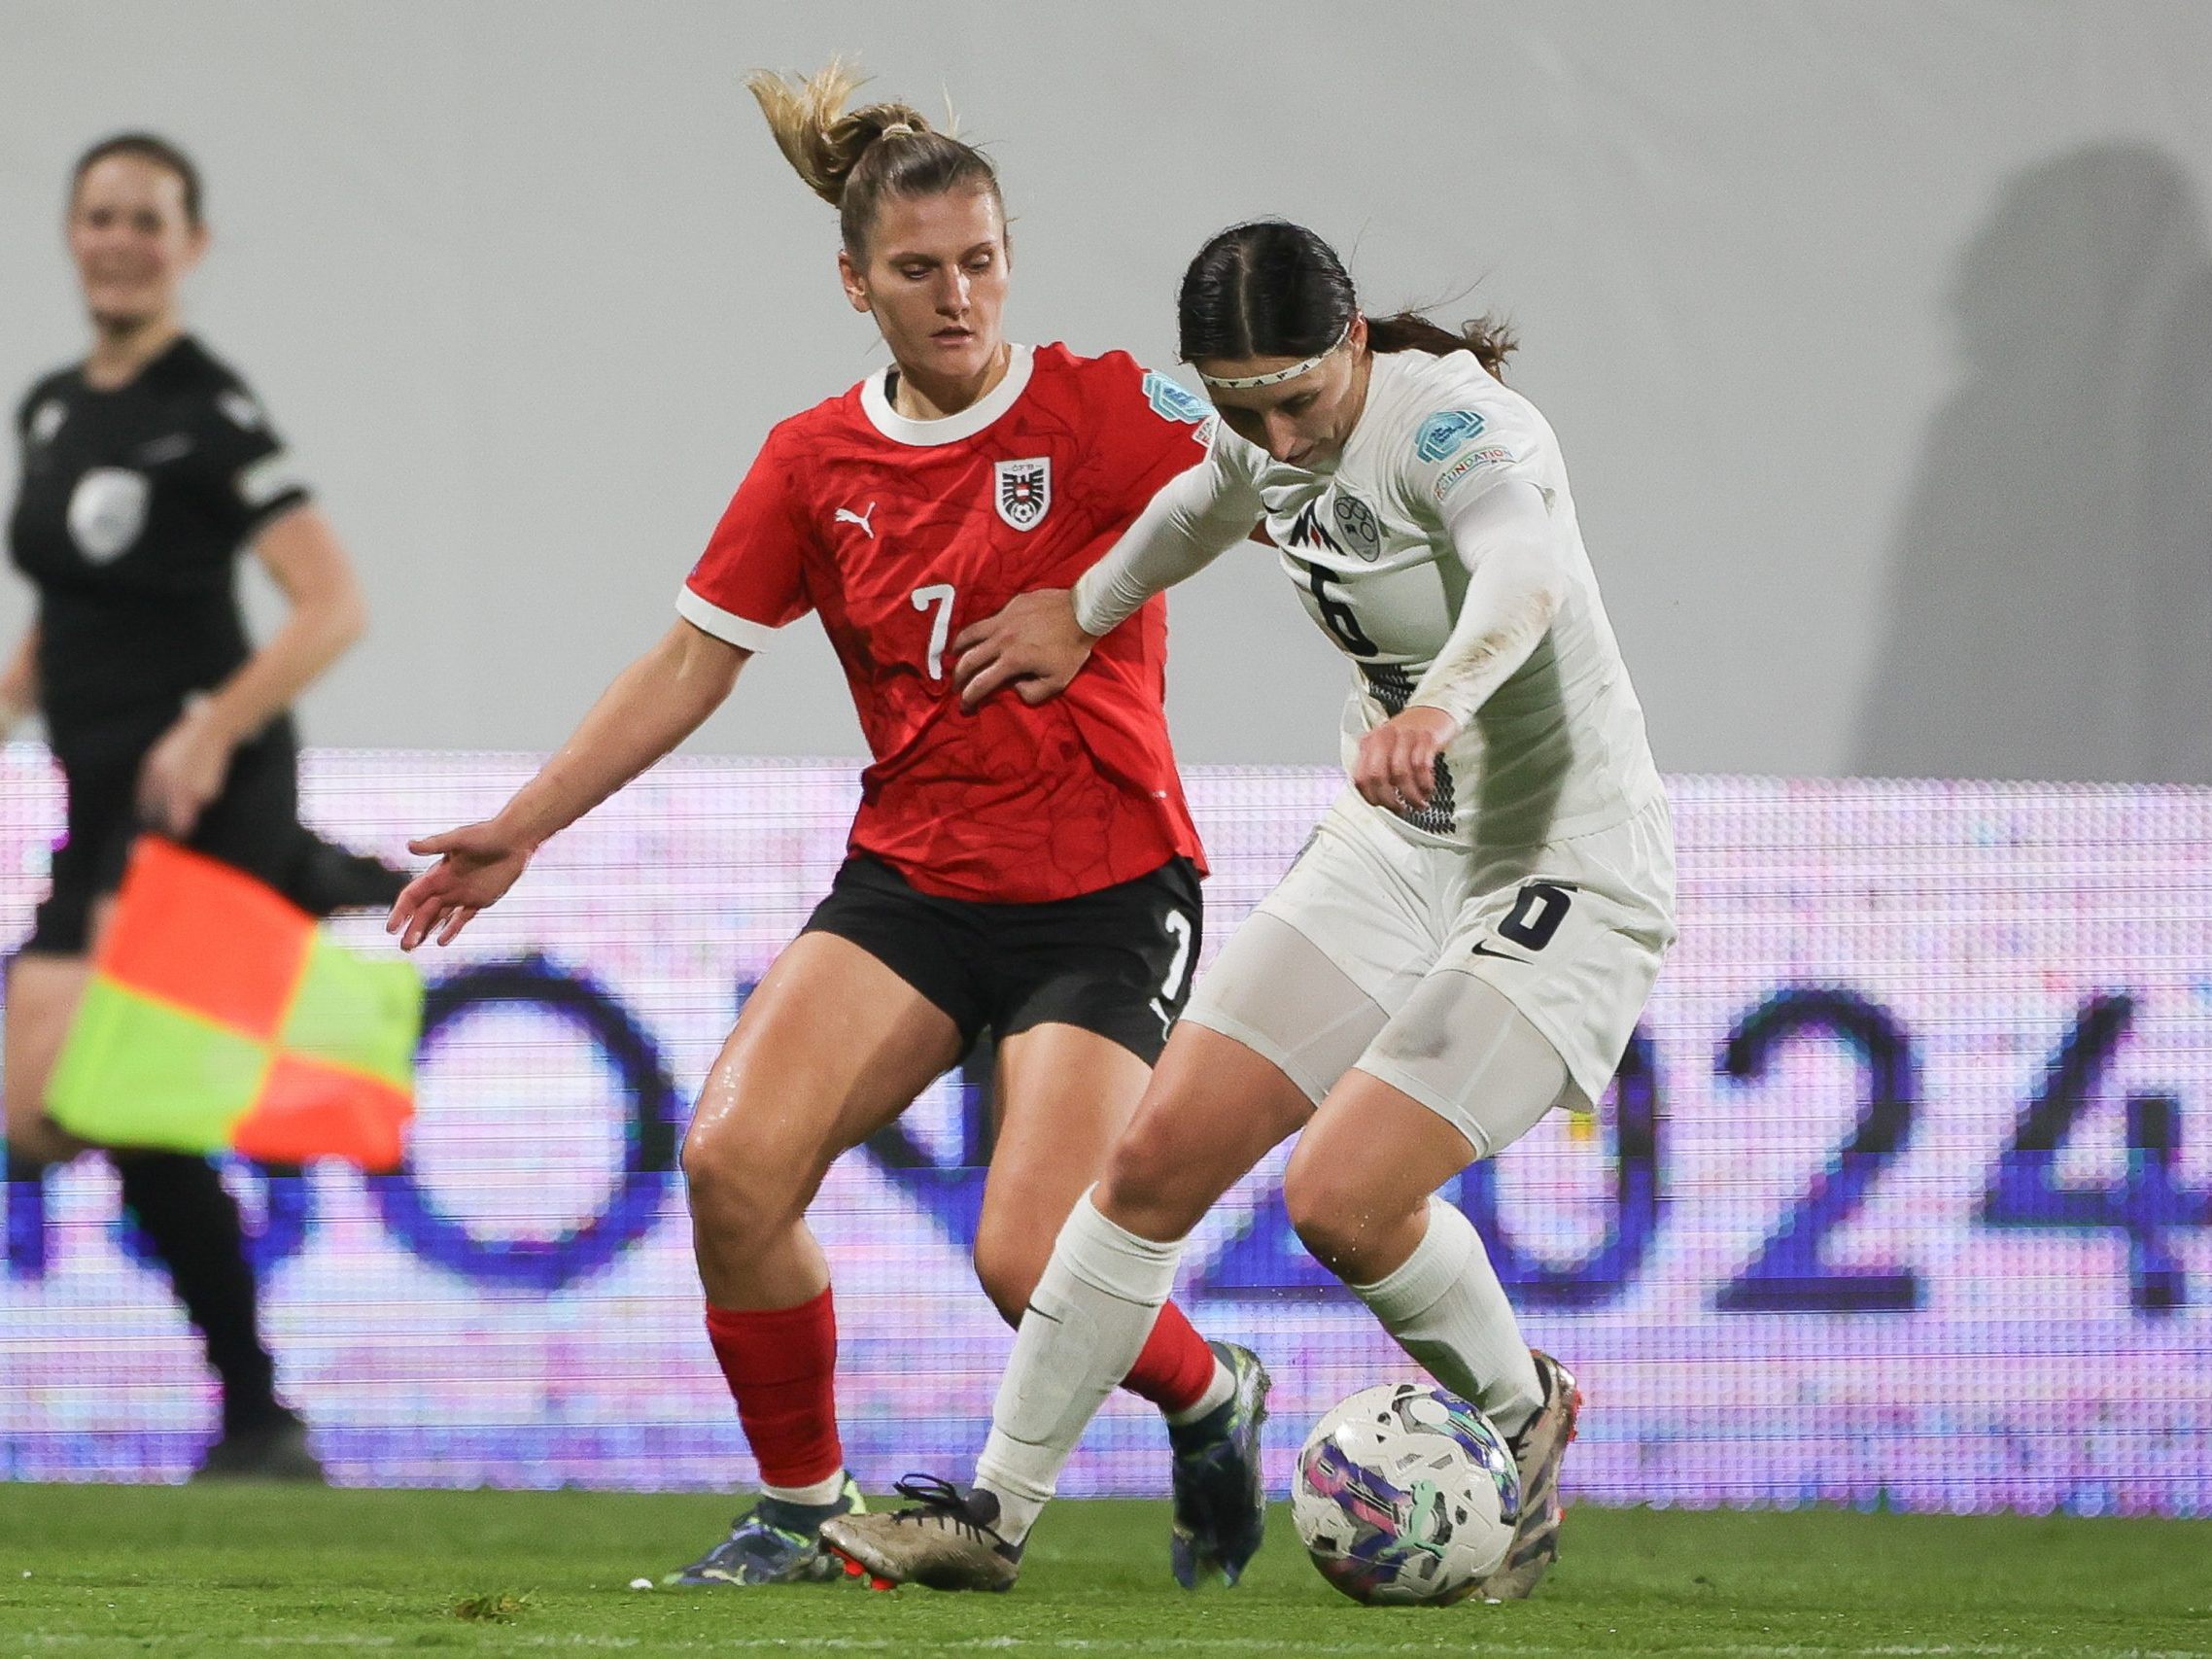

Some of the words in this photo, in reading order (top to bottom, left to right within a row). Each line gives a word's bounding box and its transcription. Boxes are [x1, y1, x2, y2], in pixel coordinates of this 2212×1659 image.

[911, 583, 955, 680] 7
[1310, 563, 1379, 657] 6
[1161, 908, 1192, 1000] 7
